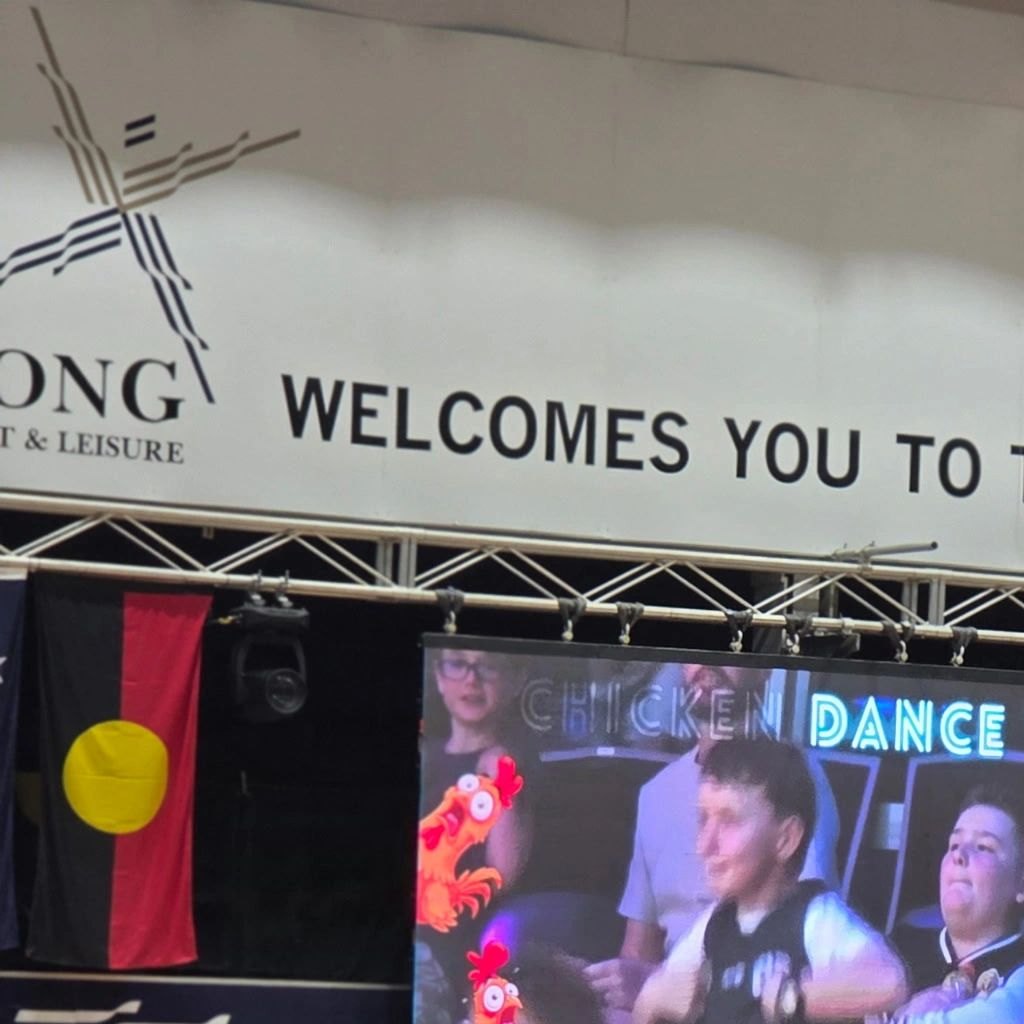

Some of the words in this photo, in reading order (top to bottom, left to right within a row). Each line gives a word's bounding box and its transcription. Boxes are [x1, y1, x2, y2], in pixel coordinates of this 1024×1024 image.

[24, 428, 48, 451] &
[57, 430, 185, 465] LEISURE
[281, 374, 690, 474] WELCOMES
[724, 417, 861, 489] YOU
[896, 433, 981, 498] TO
[520, 677, 783, 742] CHICKEN
[809, 692, 1006, 758] DANCE
